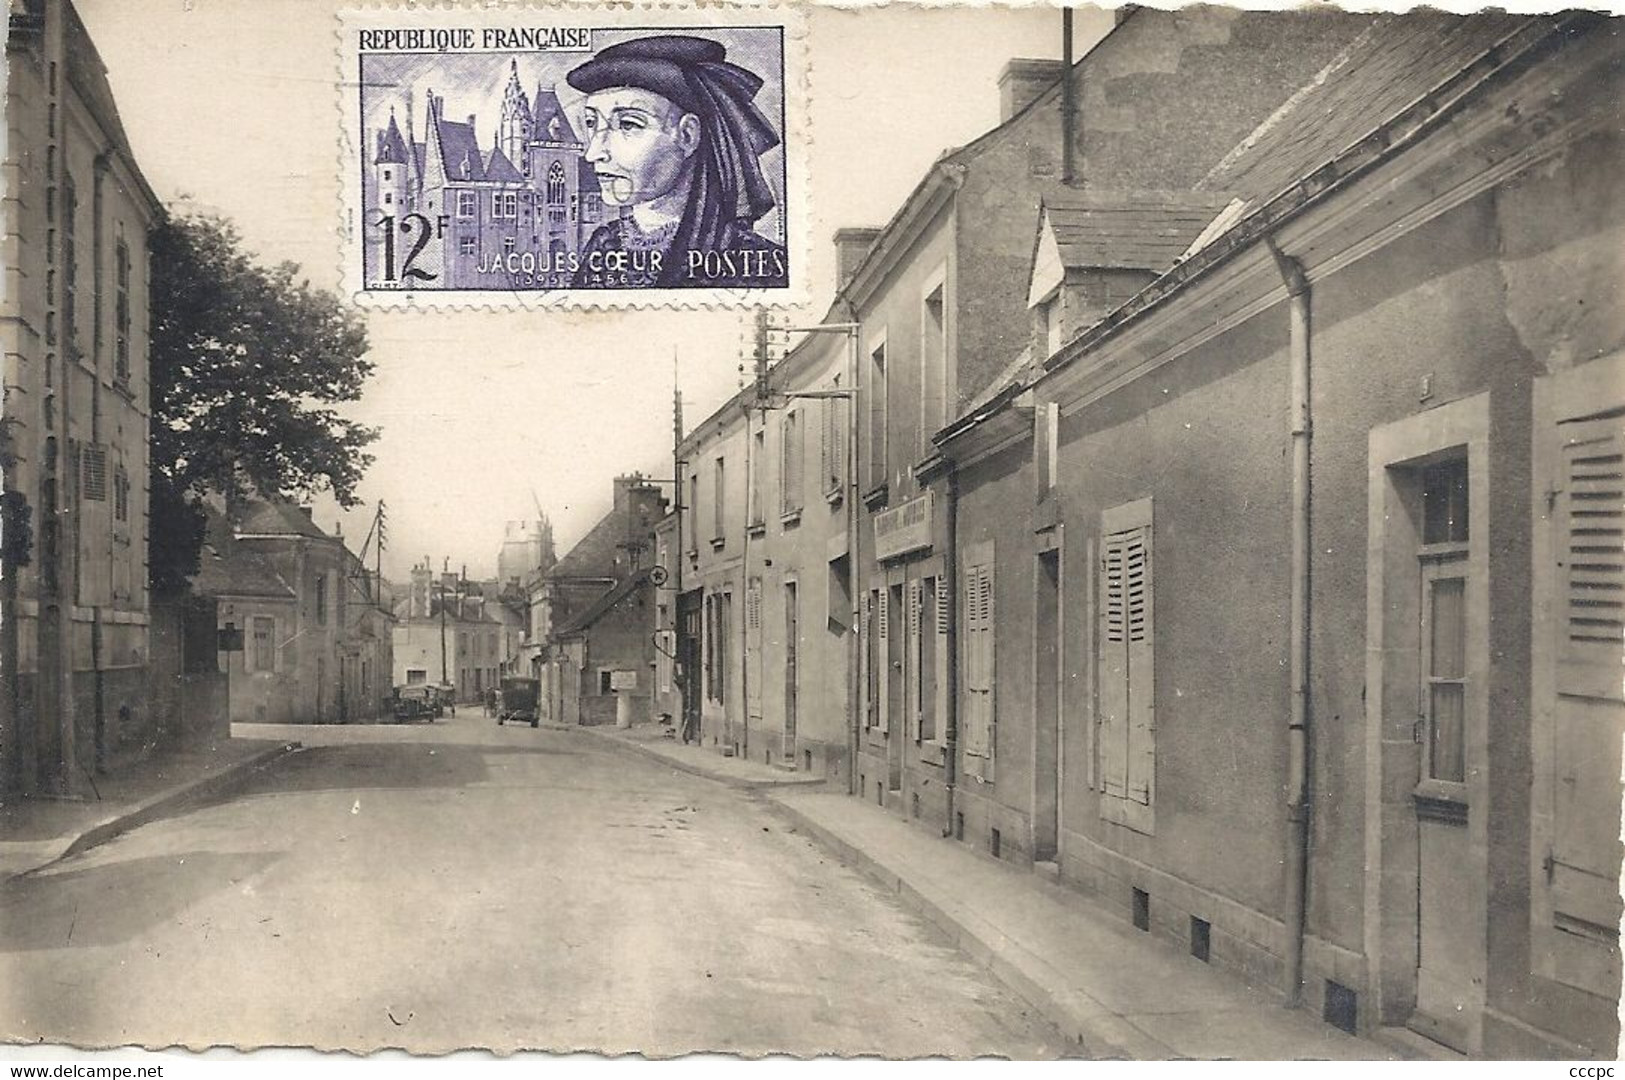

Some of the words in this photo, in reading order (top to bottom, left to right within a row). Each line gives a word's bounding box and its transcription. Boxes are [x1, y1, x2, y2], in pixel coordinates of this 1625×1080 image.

[359, 28, 475, 51] REPUBLIQUE
[482, 27, 589, 50] FRANÇAISE
[477, 252, 580, 274] JACQUES
[687, 249, 784, 278] POSTES
